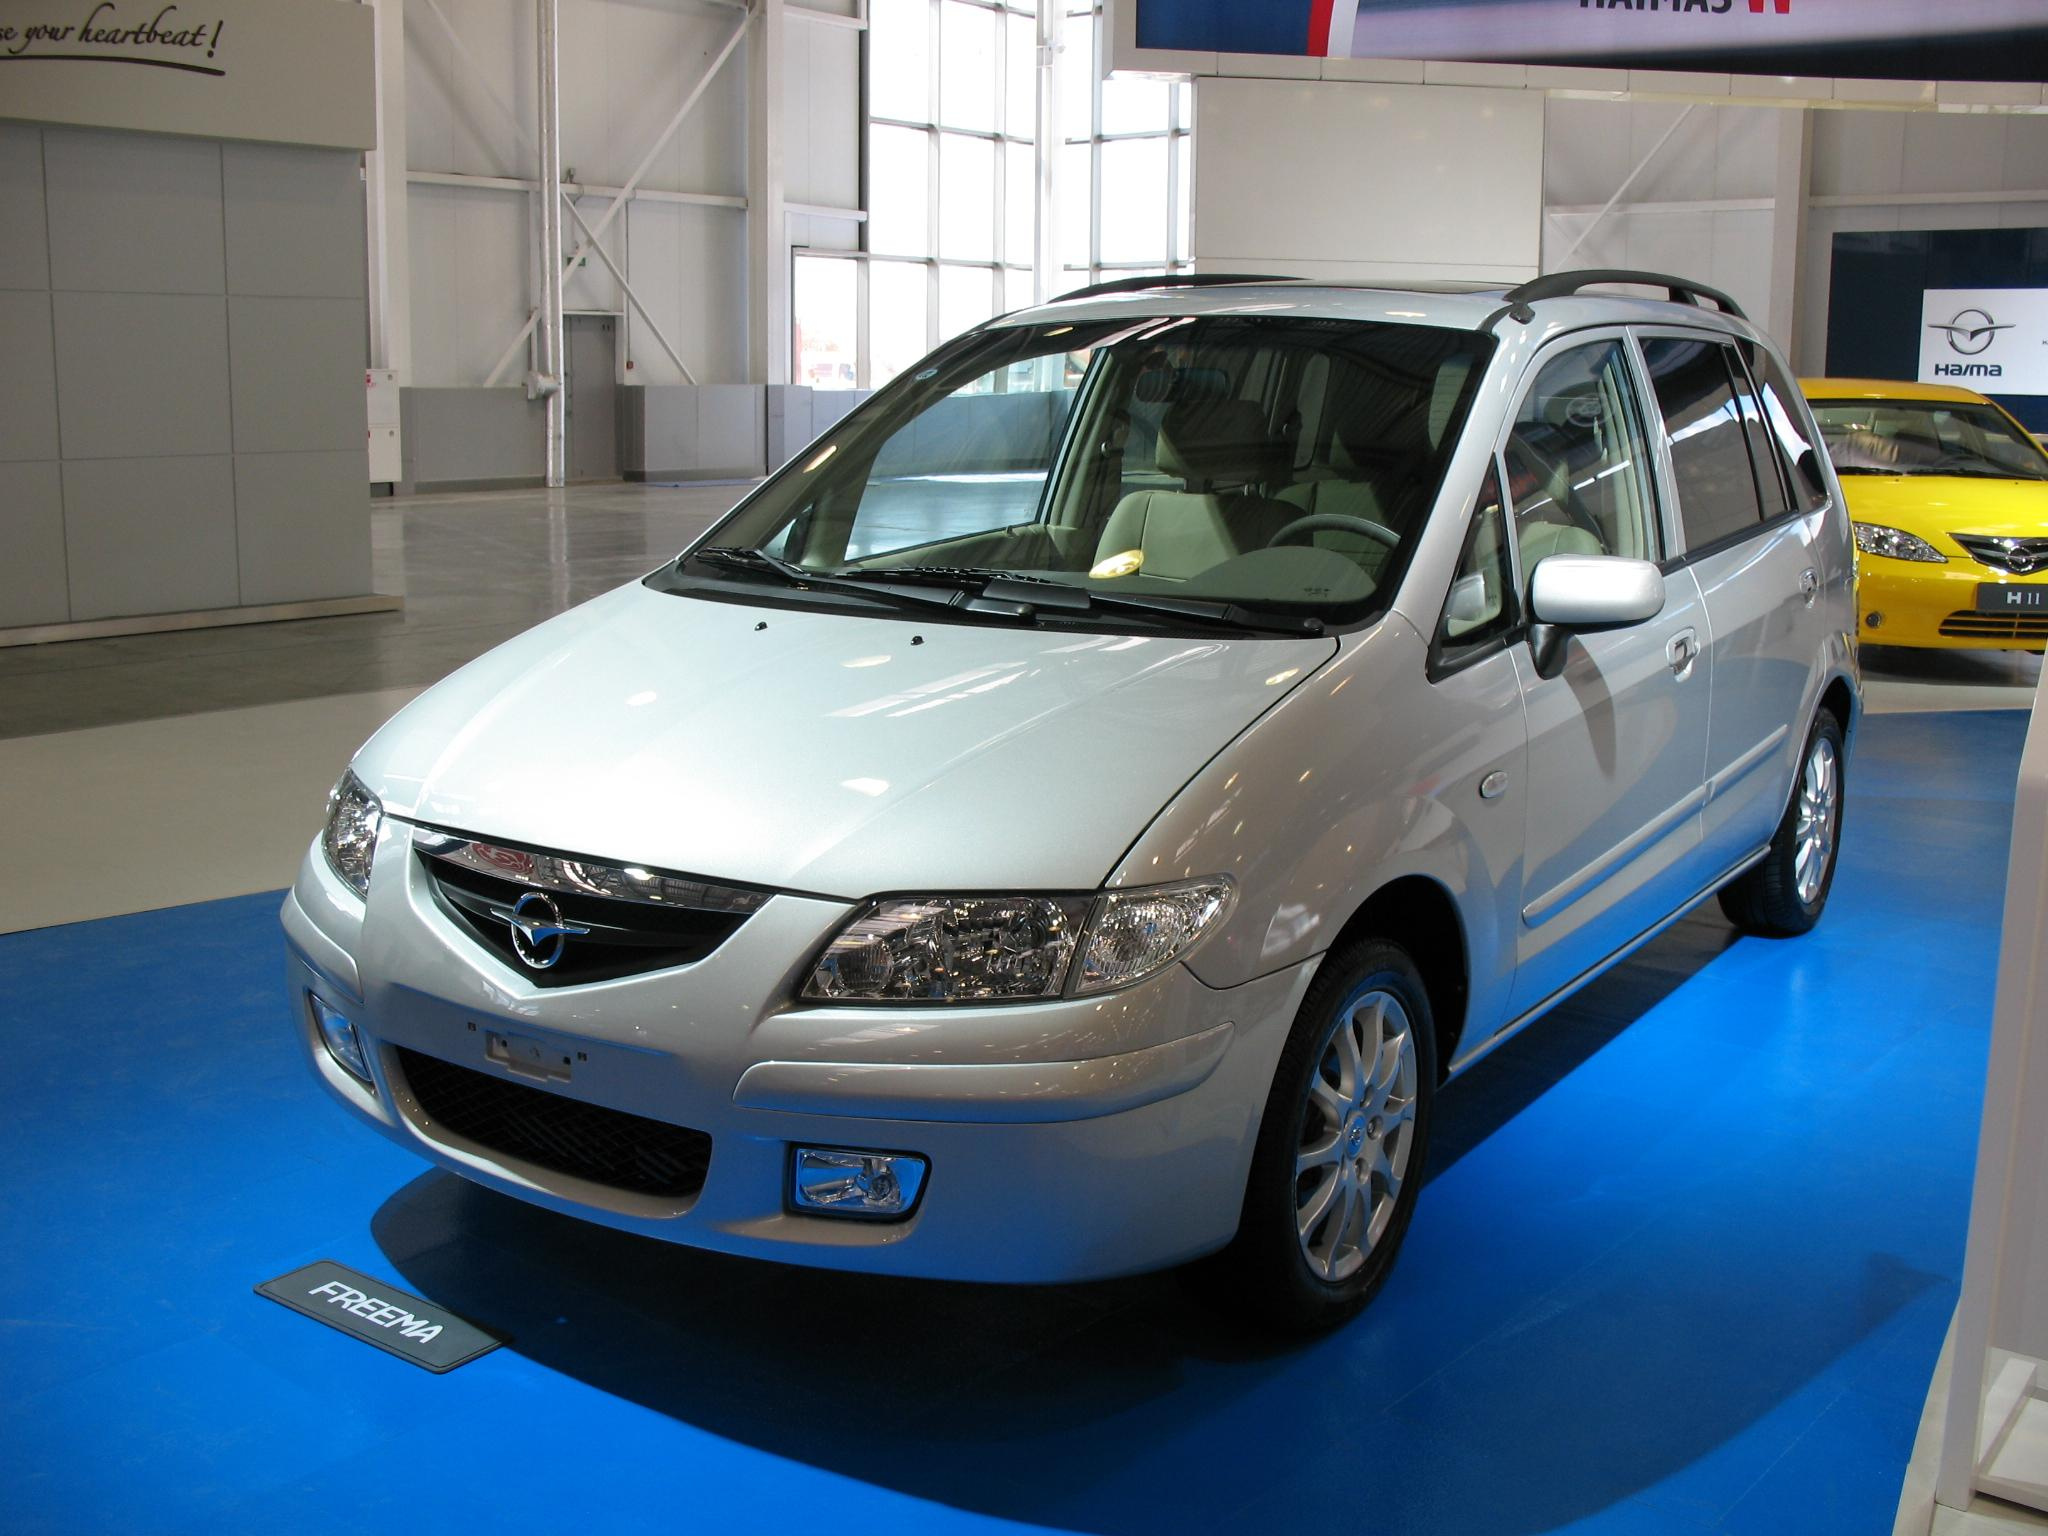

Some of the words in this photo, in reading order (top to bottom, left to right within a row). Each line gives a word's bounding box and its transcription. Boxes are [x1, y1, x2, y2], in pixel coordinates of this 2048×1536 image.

[8, 25, 75, 54] your
[78, 2, 223, 58] heartbeat!
[308, 1281, 443, 1344] FREEMA
